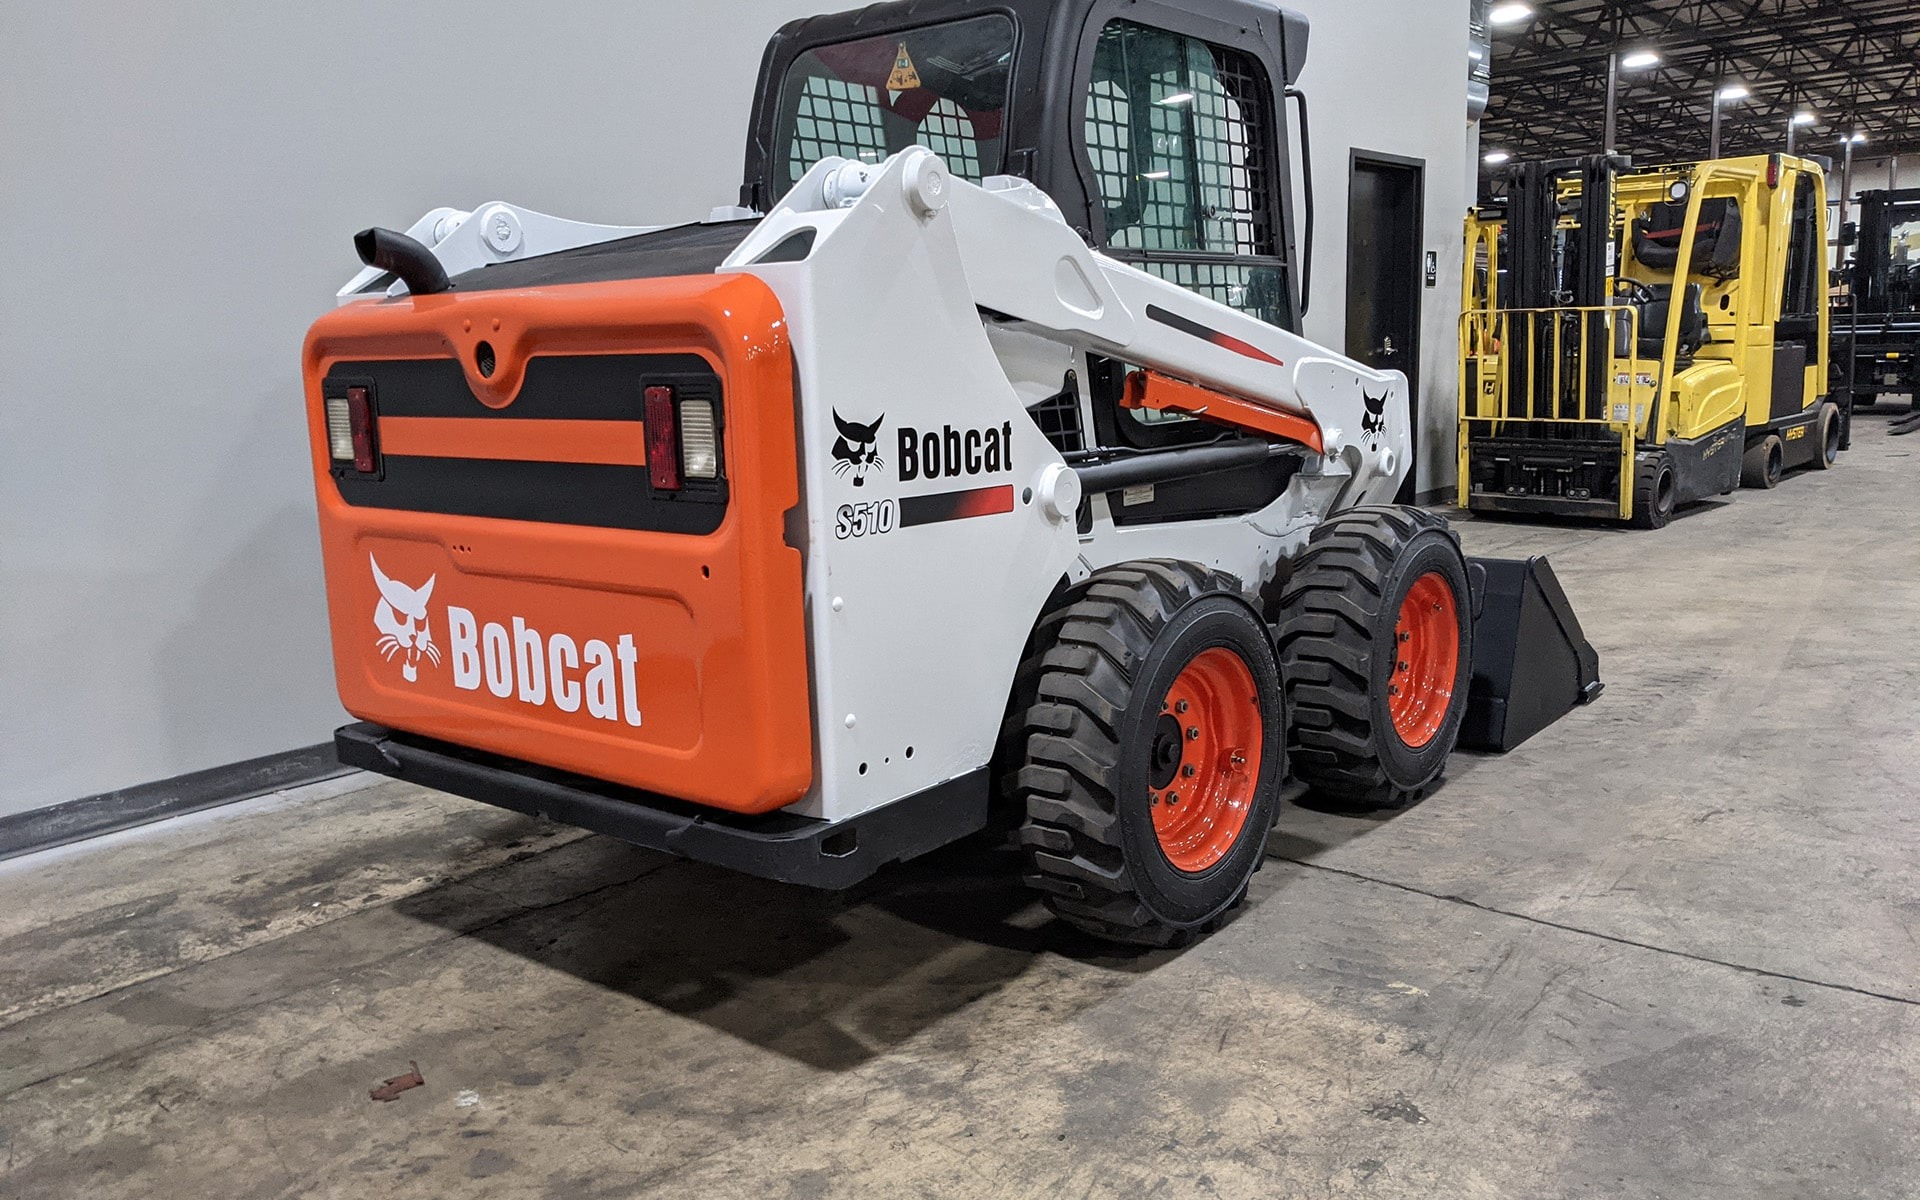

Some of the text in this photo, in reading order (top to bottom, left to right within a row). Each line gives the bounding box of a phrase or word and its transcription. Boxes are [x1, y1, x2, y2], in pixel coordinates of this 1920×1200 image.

[1608, 170, 1616, 239] HYSTER
[898, 421, 1012, 482] Bobcat
[835, 499, 894, 540] S510
[447, 605, 642, 727] Bobcat
